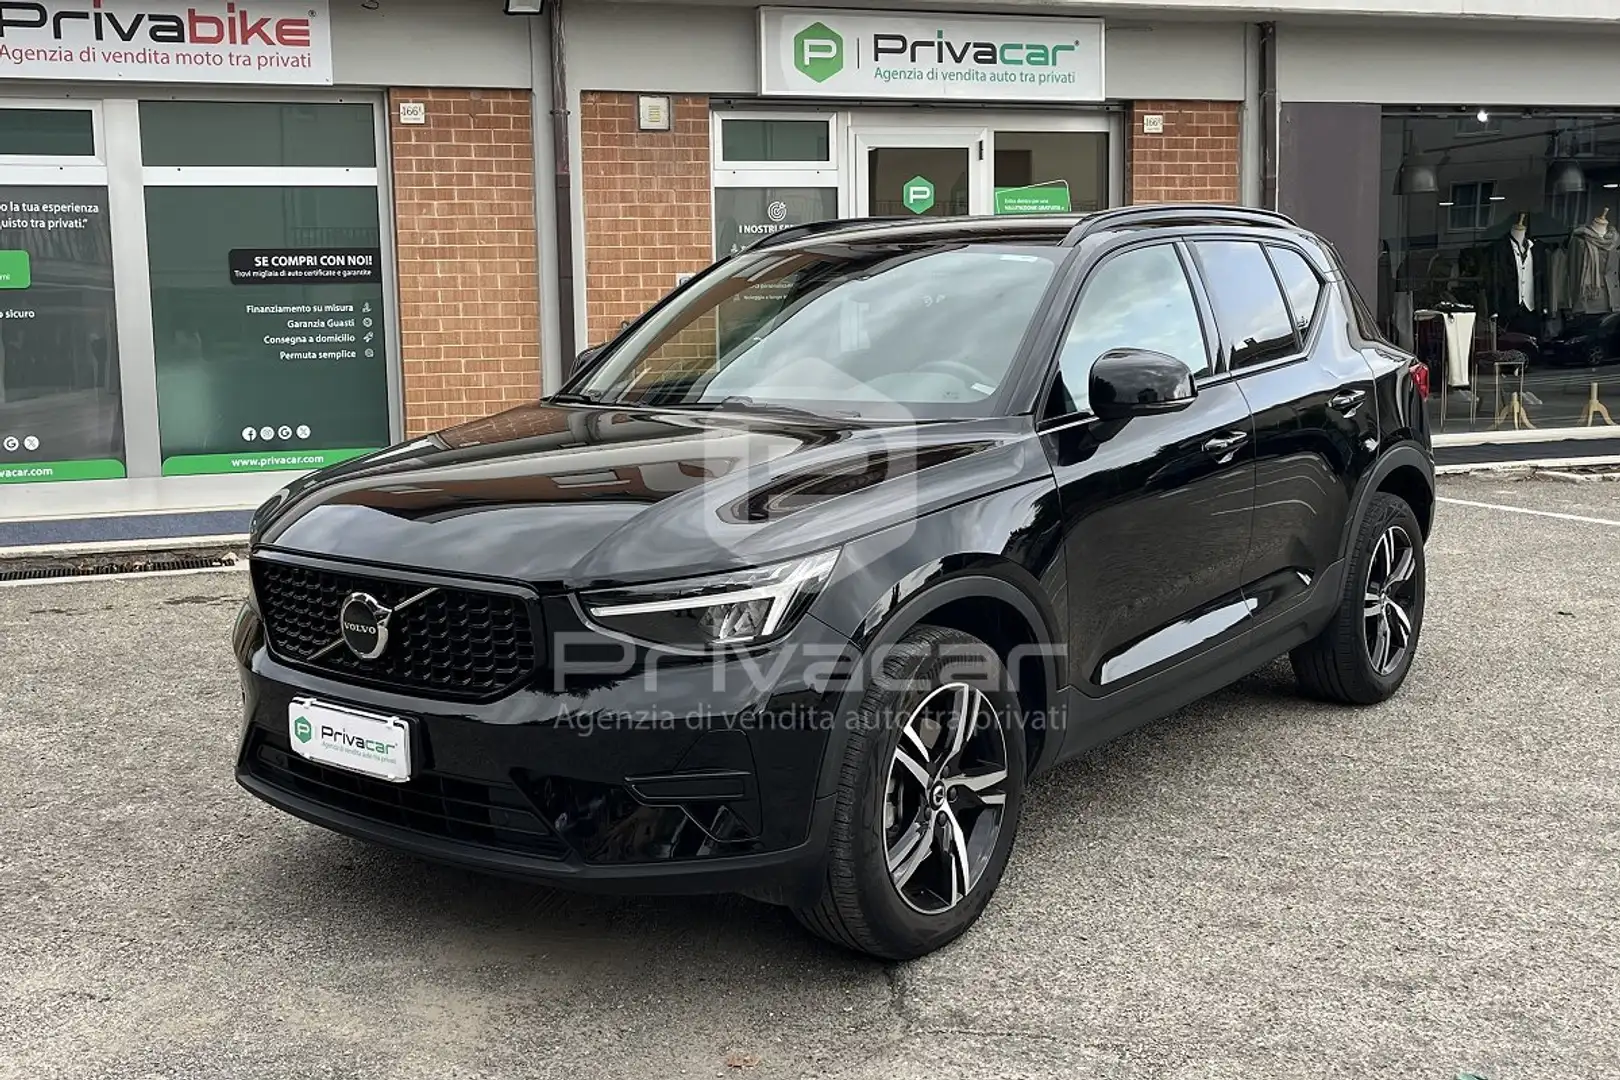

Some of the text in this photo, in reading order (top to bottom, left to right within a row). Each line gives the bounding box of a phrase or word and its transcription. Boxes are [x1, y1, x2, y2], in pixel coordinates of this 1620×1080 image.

[0, 0, 311, 46] Privabike
[873, 29, 1075, 67] Privacar
[0, 44, 312, 70] Agenzia di vendita moto tra privati
[874, 67, 1076, 85] Agenzia di vendita auto tra privati
[9, 201, 20, 212] la
[21, 202, 40, 212] tua
[41, 202, 100, 215] esperienza
[0, 217, 28, 230] uisto
[30, 219, 46, 229] tra
[744, 224, 777, 233] NOSTRI
[253, 255, 373, 267] SE COMPRI CON NOI!
[234, 269, 251, 278] Trovi
[303, 268, 336, 278] certificate
[5, 308, 35, 319] sicuro
[246, 304, 312, 313] Finanziamento
[324, 303, 354, 312] misura
[287, 318, 355, 329] Garanzia Guasti
[263, 334, 307, 345] Consegna
[315, 333, 356, 343] domicilio
[279, 349, 356, 360] Permuta semplice
[231, 454, 324, 467] www.privacar.com
[343, 621, 376, 635] VOLVO
[321, 724, 396, 755] Privacar
